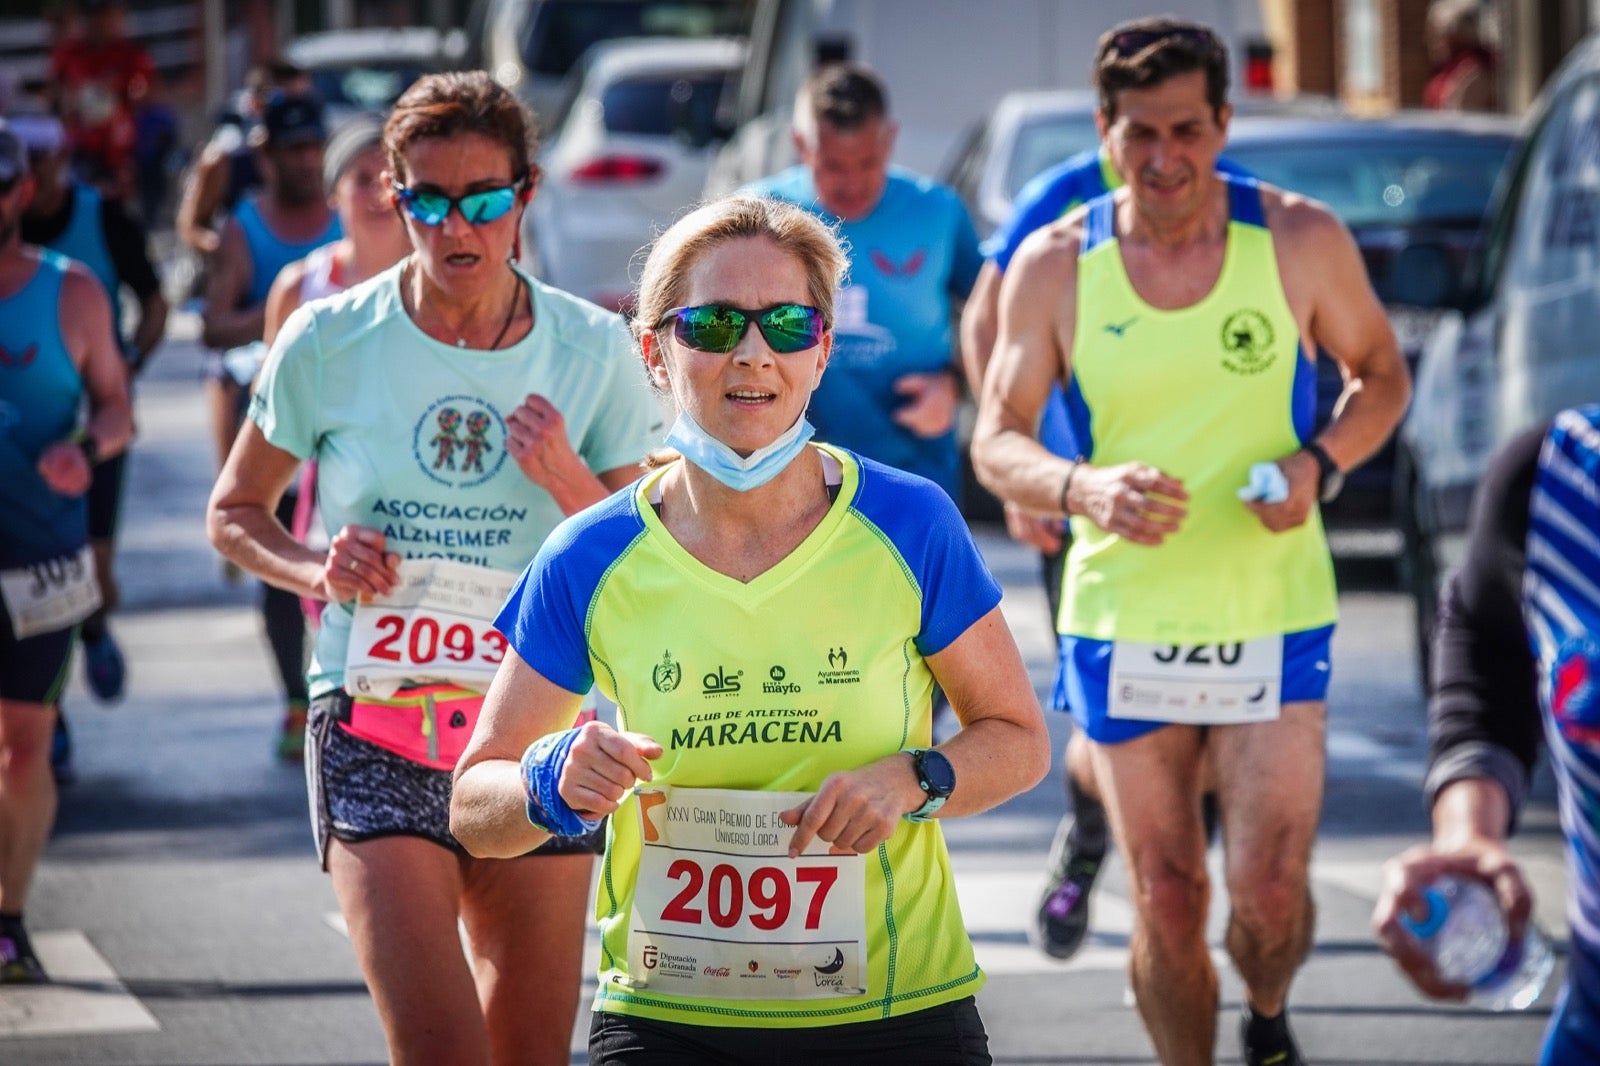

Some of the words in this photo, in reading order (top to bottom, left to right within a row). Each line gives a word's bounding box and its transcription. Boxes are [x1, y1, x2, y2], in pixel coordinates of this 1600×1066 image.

[372, 498, 528, 522] ASOCIACIÓN
[384, 523, 512, 547] ALZHEIMER
[367, 614, 511, 665] 2093
[703, 665, 741, 690] als
[817, 669, 860, 678] Ayuntamiento
[825, 676, 861, 685] Maracena
[762, 682, 802, 695] mayfo
[687, 711, 721, 723] CLUB
[725, 709, 742, 719] DE
[745, 708, 819, 719] ATLETISMO
[670, 720, 843, 750] MARACENA
[666, 806, 690, 822] XXXV
[693, 807, 717, 825] GRAN
[719, 808, 752, 828] PREMIO
[755, 814, 768, 829] DE
[714, 828, 750, 846] UNIVERSO
[752, 831, 779, 846] LORCA
[659, 859, 839, 931] 2097
[659, 960, 668, 969] de
[667, 962, 697, 972] Granada
[660, 952, 697, 964] Diputación
[814, 971, 844, 987] Lorca
